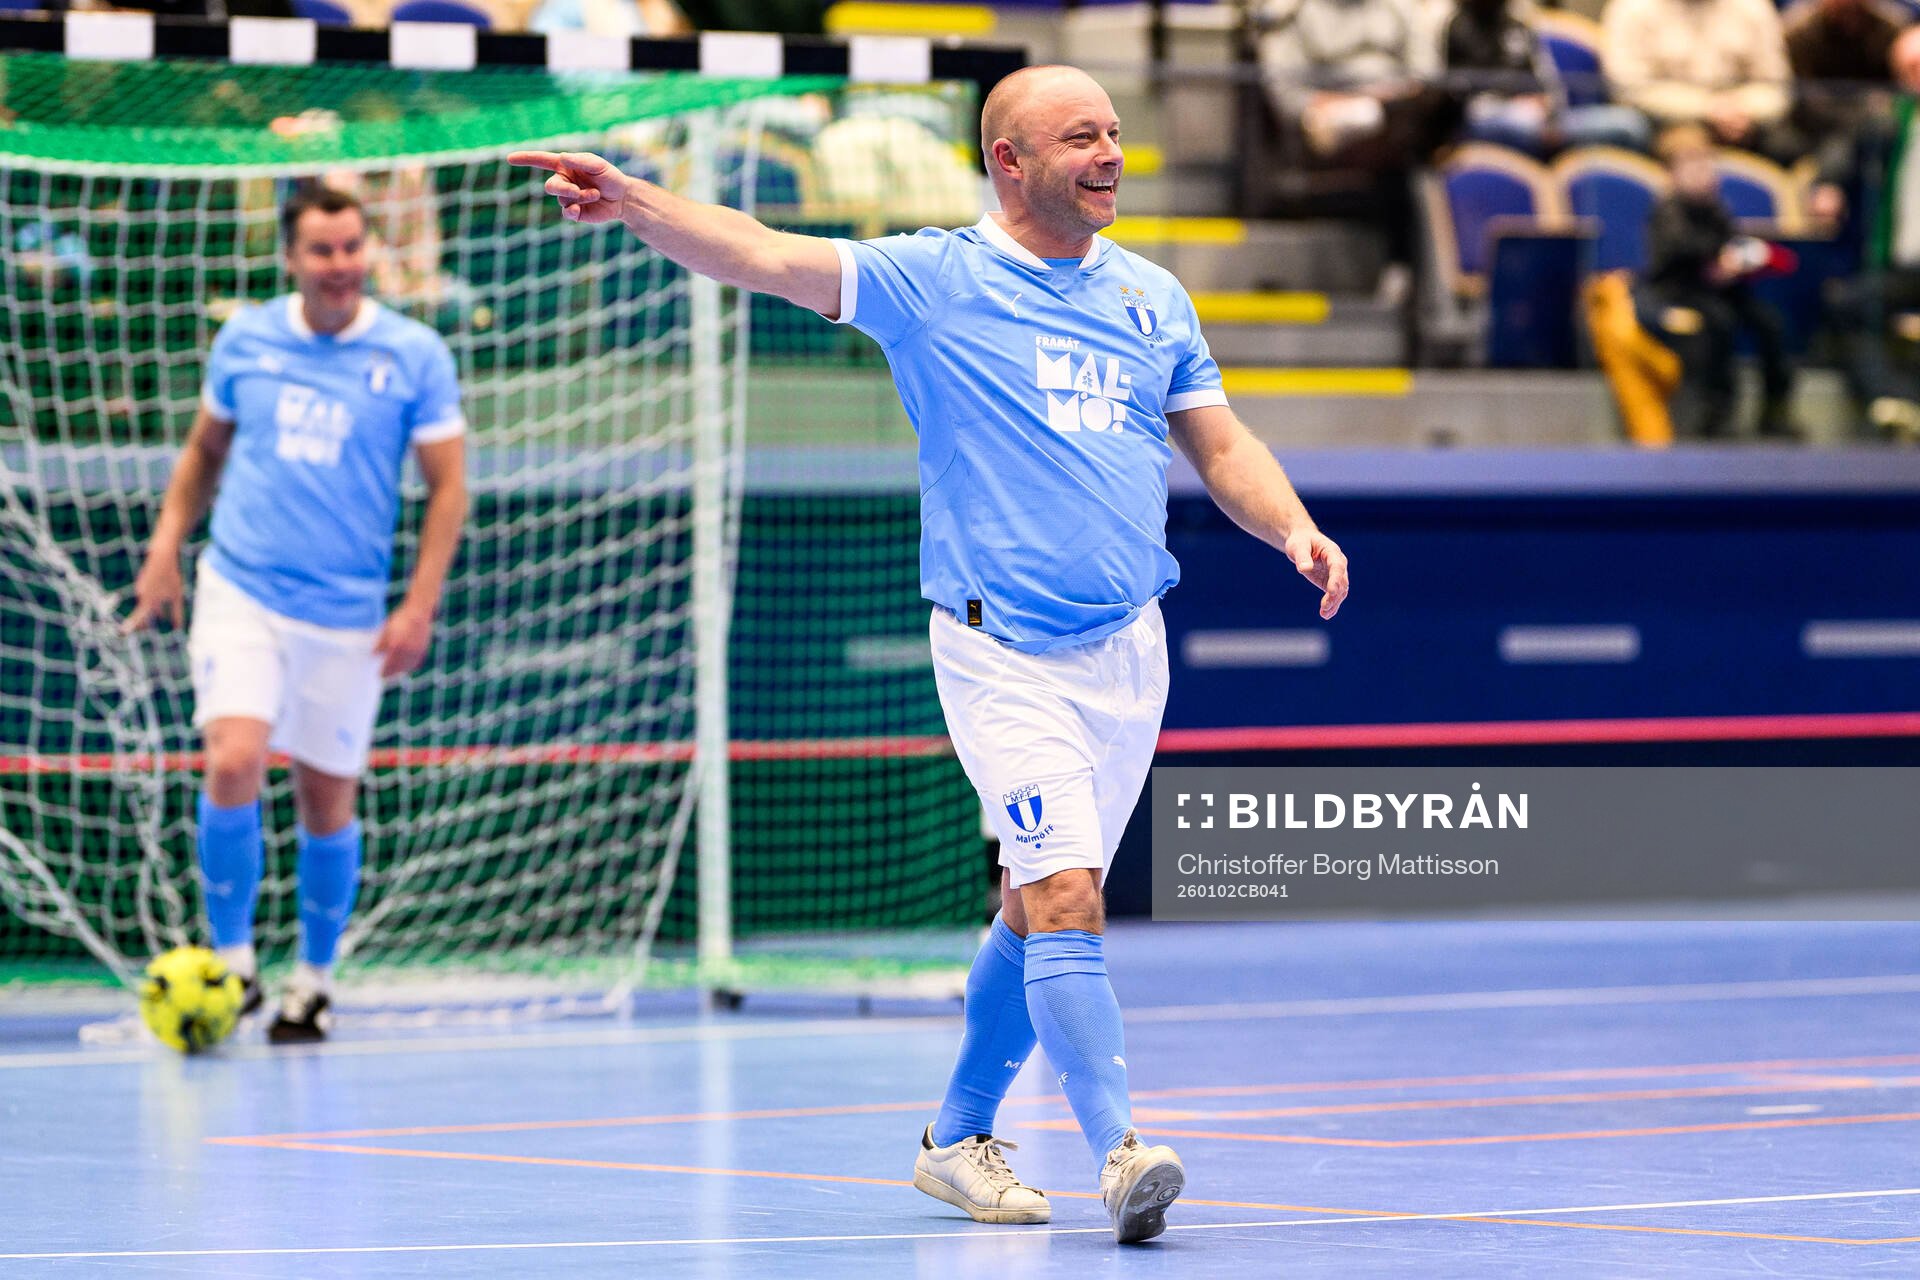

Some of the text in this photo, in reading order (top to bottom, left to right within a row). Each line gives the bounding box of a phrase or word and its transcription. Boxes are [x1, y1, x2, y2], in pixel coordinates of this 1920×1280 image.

[1035, 335, 1080, 349] FRAMÅT
[1015, 824, 1054, 843] Malmö FF
